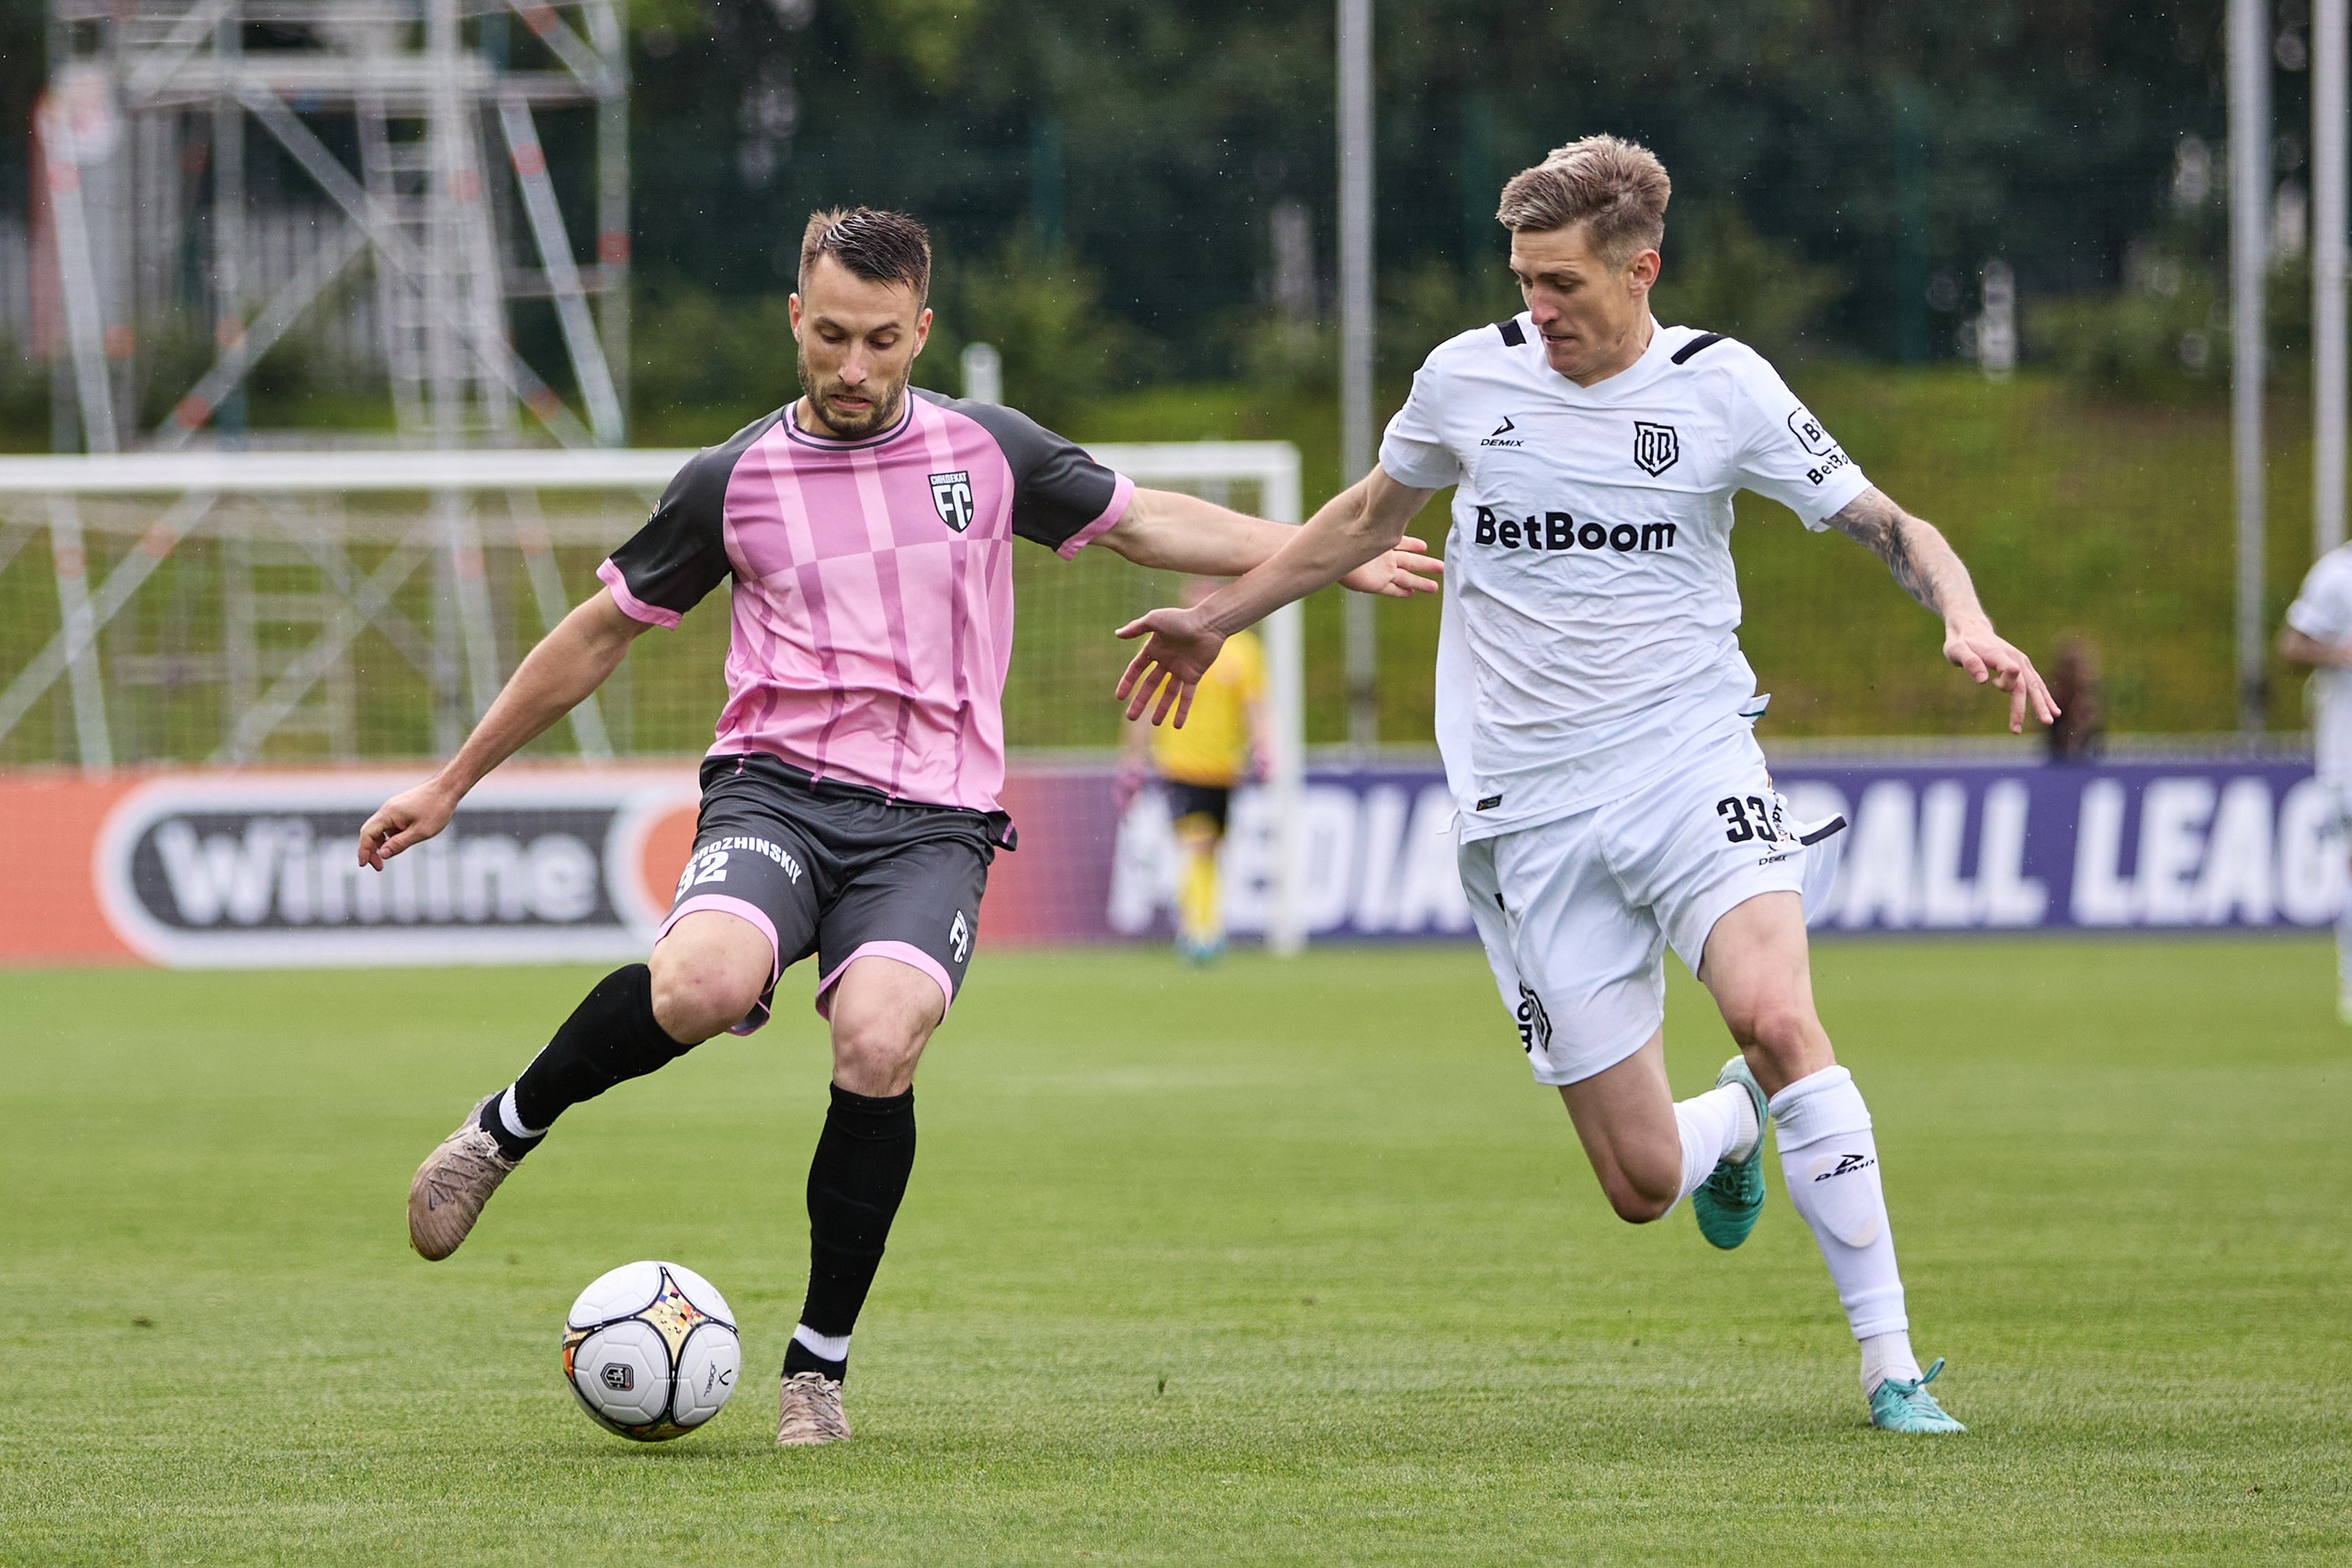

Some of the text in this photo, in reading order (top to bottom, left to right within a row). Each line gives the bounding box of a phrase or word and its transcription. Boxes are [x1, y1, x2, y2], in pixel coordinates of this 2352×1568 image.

[1480, 438, 1525, 447] DEMIX
[932, 482, 973, 530] FC
[1475, 506, 1677, 551] BetBoom
[1716, 795, 1778, 843] 33
[153, 816, 597, 925] Winline
[1815, 1158, 1875, 1182] DEMIX
